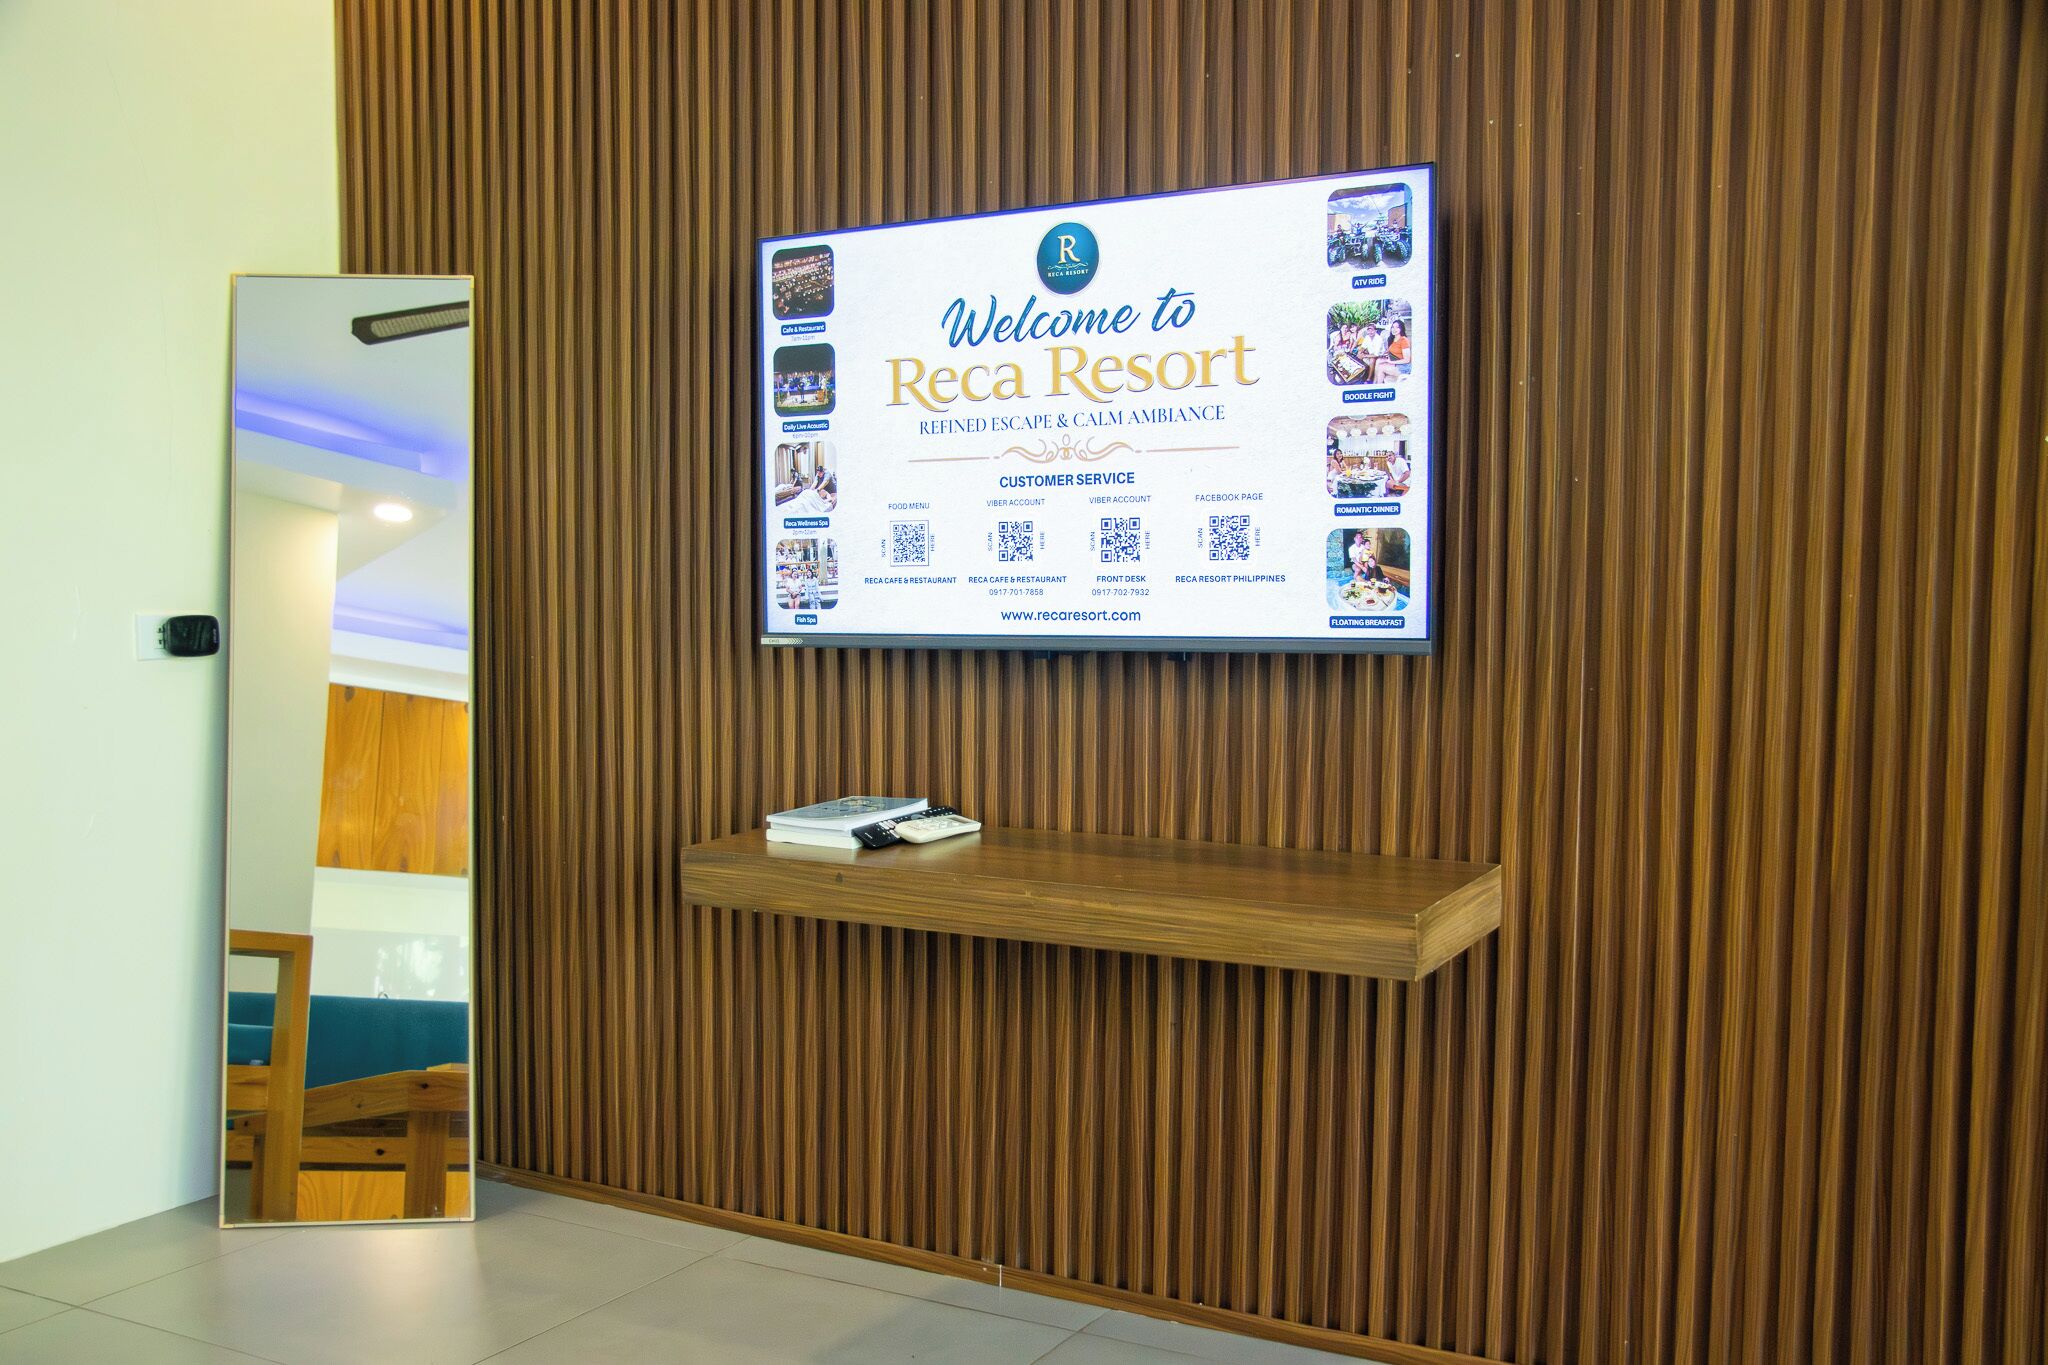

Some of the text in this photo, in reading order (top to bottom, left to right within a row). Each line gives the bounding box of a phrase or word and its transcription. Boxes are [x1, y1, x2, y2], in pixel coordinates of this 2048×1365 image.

[1057, 234, 1081, 264] R
[1354, 278, 1385, 286] ATV RIDE
[941, 287, 1196, 348] Welcome to
[885, 335, 1261, 413] Reca Resort
[1344, 391, 1394, 400] BOODLE FIGHT
[920, 404, 1225, 435] REFINED ESCAPE & CALM AMBIANCE
[999, 472, 1136, 488] CUSTOMER SERVICE
[1008, 498, 1046, 506] ACCOUNT
[1112, 495, 1152, 504] ACCOUNT
[1195, 493, 1264, 502] FACEBOOK PAGE
[1016, 576, 1067, 584] RESTAURANT
[1233, 575, 1286, 583] PHILIPPINES
[1000, 610, 1142, 622] www.recaresort.com
